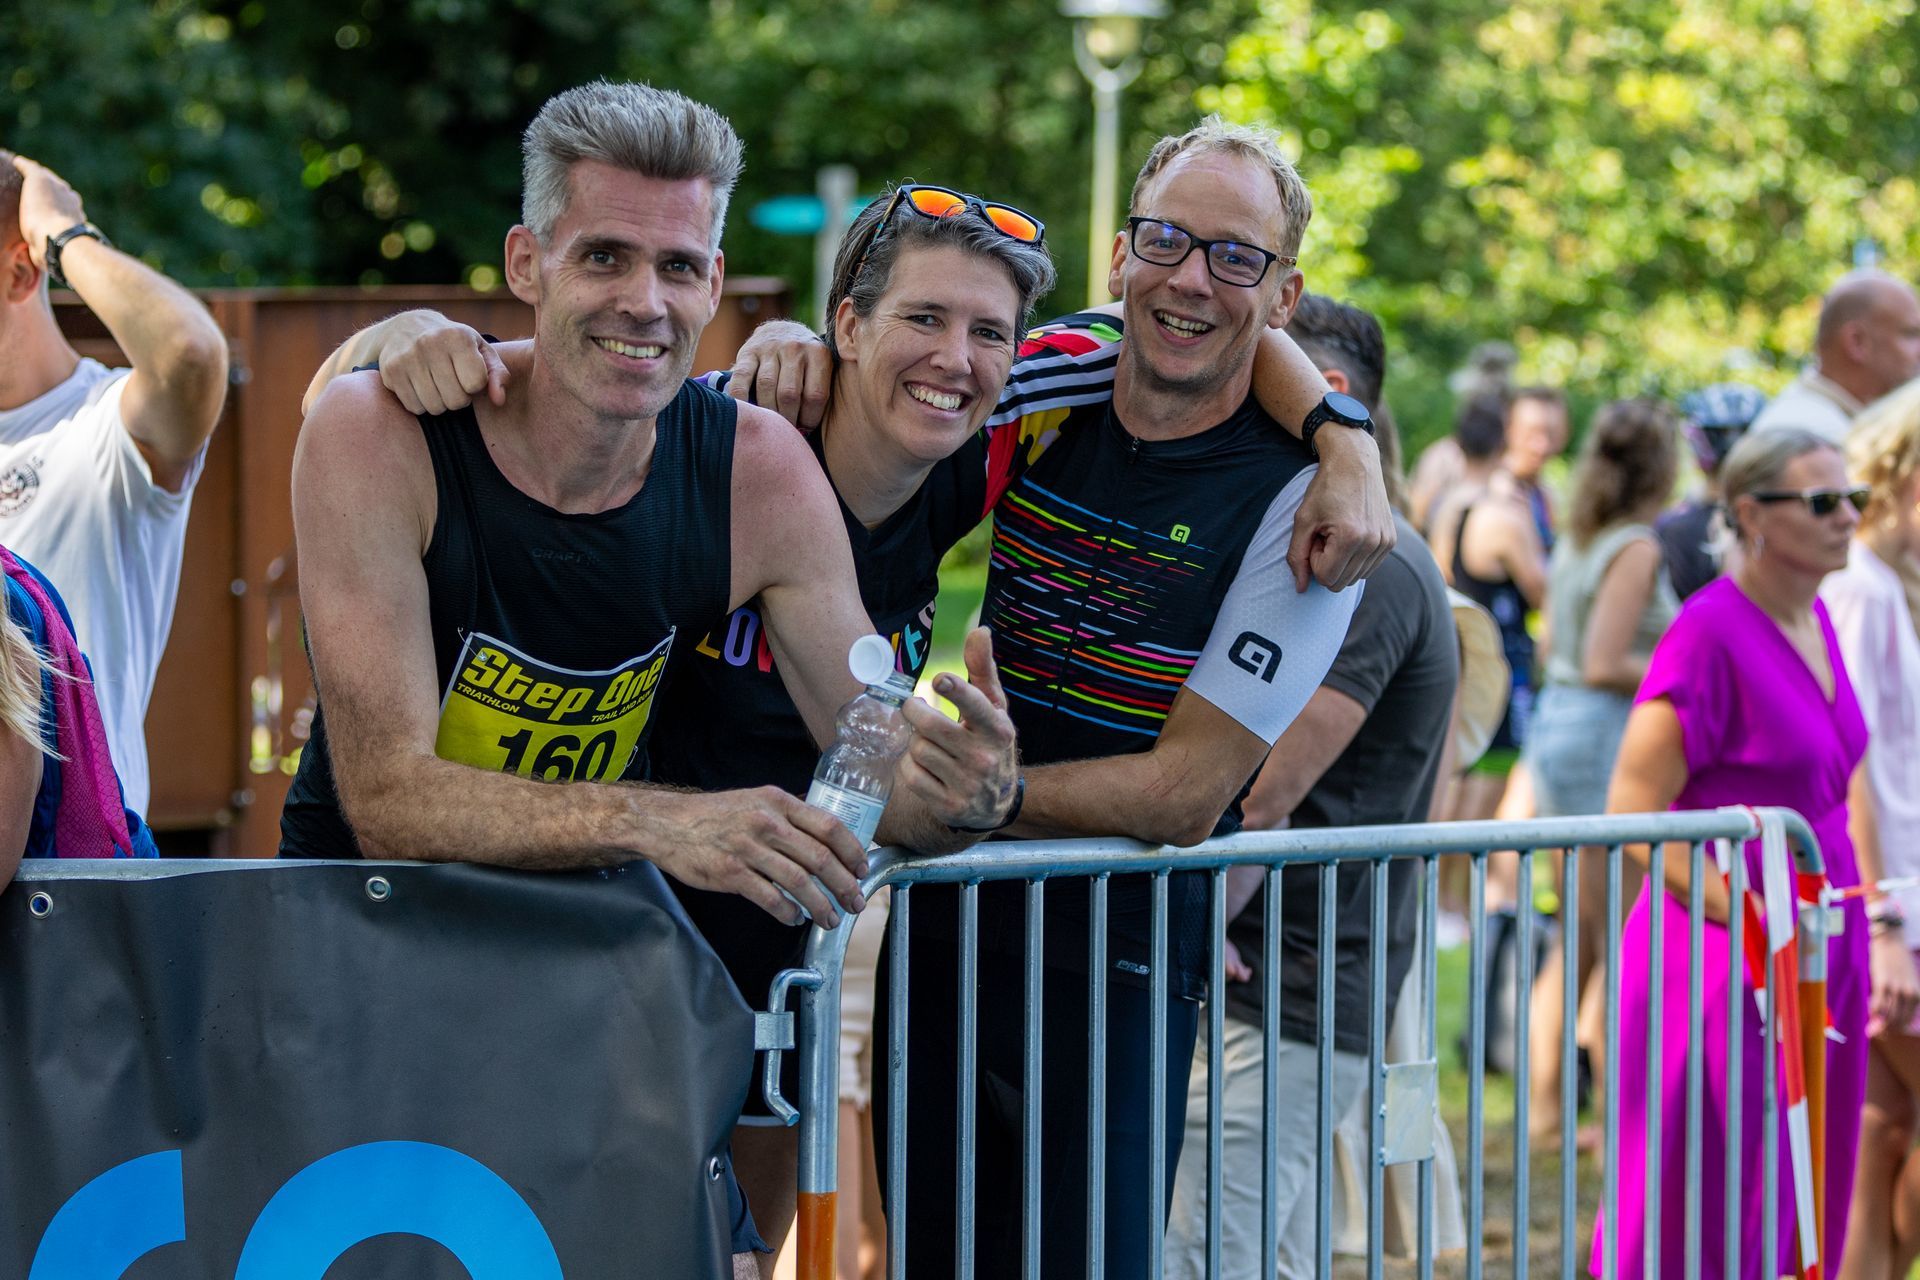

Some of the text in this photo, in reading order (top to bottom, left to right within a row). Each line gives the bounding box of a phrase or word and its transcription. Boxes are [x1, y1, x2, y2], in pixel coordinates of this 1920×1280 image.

[456, 683, 520, 714] TRIATHLON
[461, 647, 665, 721] Step One
[591, 709, 618, 723] TRAIL
[619, 701, 637, 716] AND
[497, 728, 618, 784] 160
